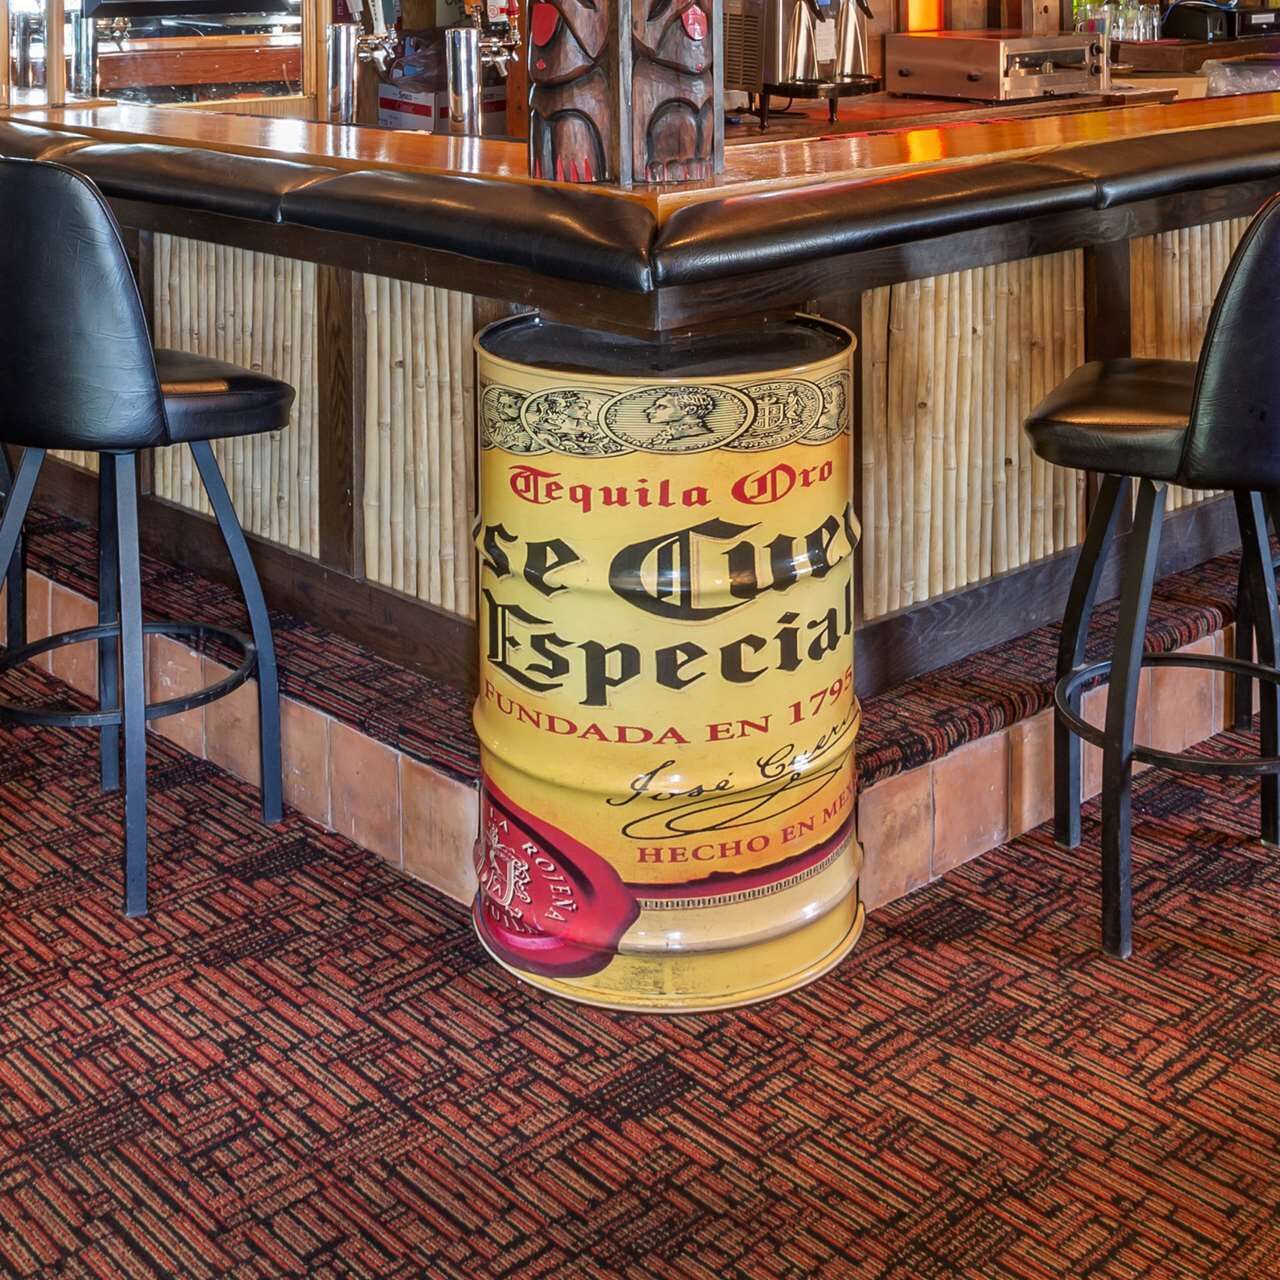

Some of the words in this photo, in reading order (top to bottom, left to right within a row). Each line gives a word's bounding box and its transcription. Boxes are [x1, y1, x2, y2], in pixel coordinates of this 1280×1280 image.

[509, 464, 711, 513] Tequila
[731, 459, 833, 505] Oro
[482, 581, 853, 706] Especial
[485, 679, 691, 745] FUNDADA
[706, 714, 773, 742] EN
[636, 835, 770, 864] HECHO
[780, 816, 815, 845] EN
[521, 841, 580, 921] ROJEÑA
